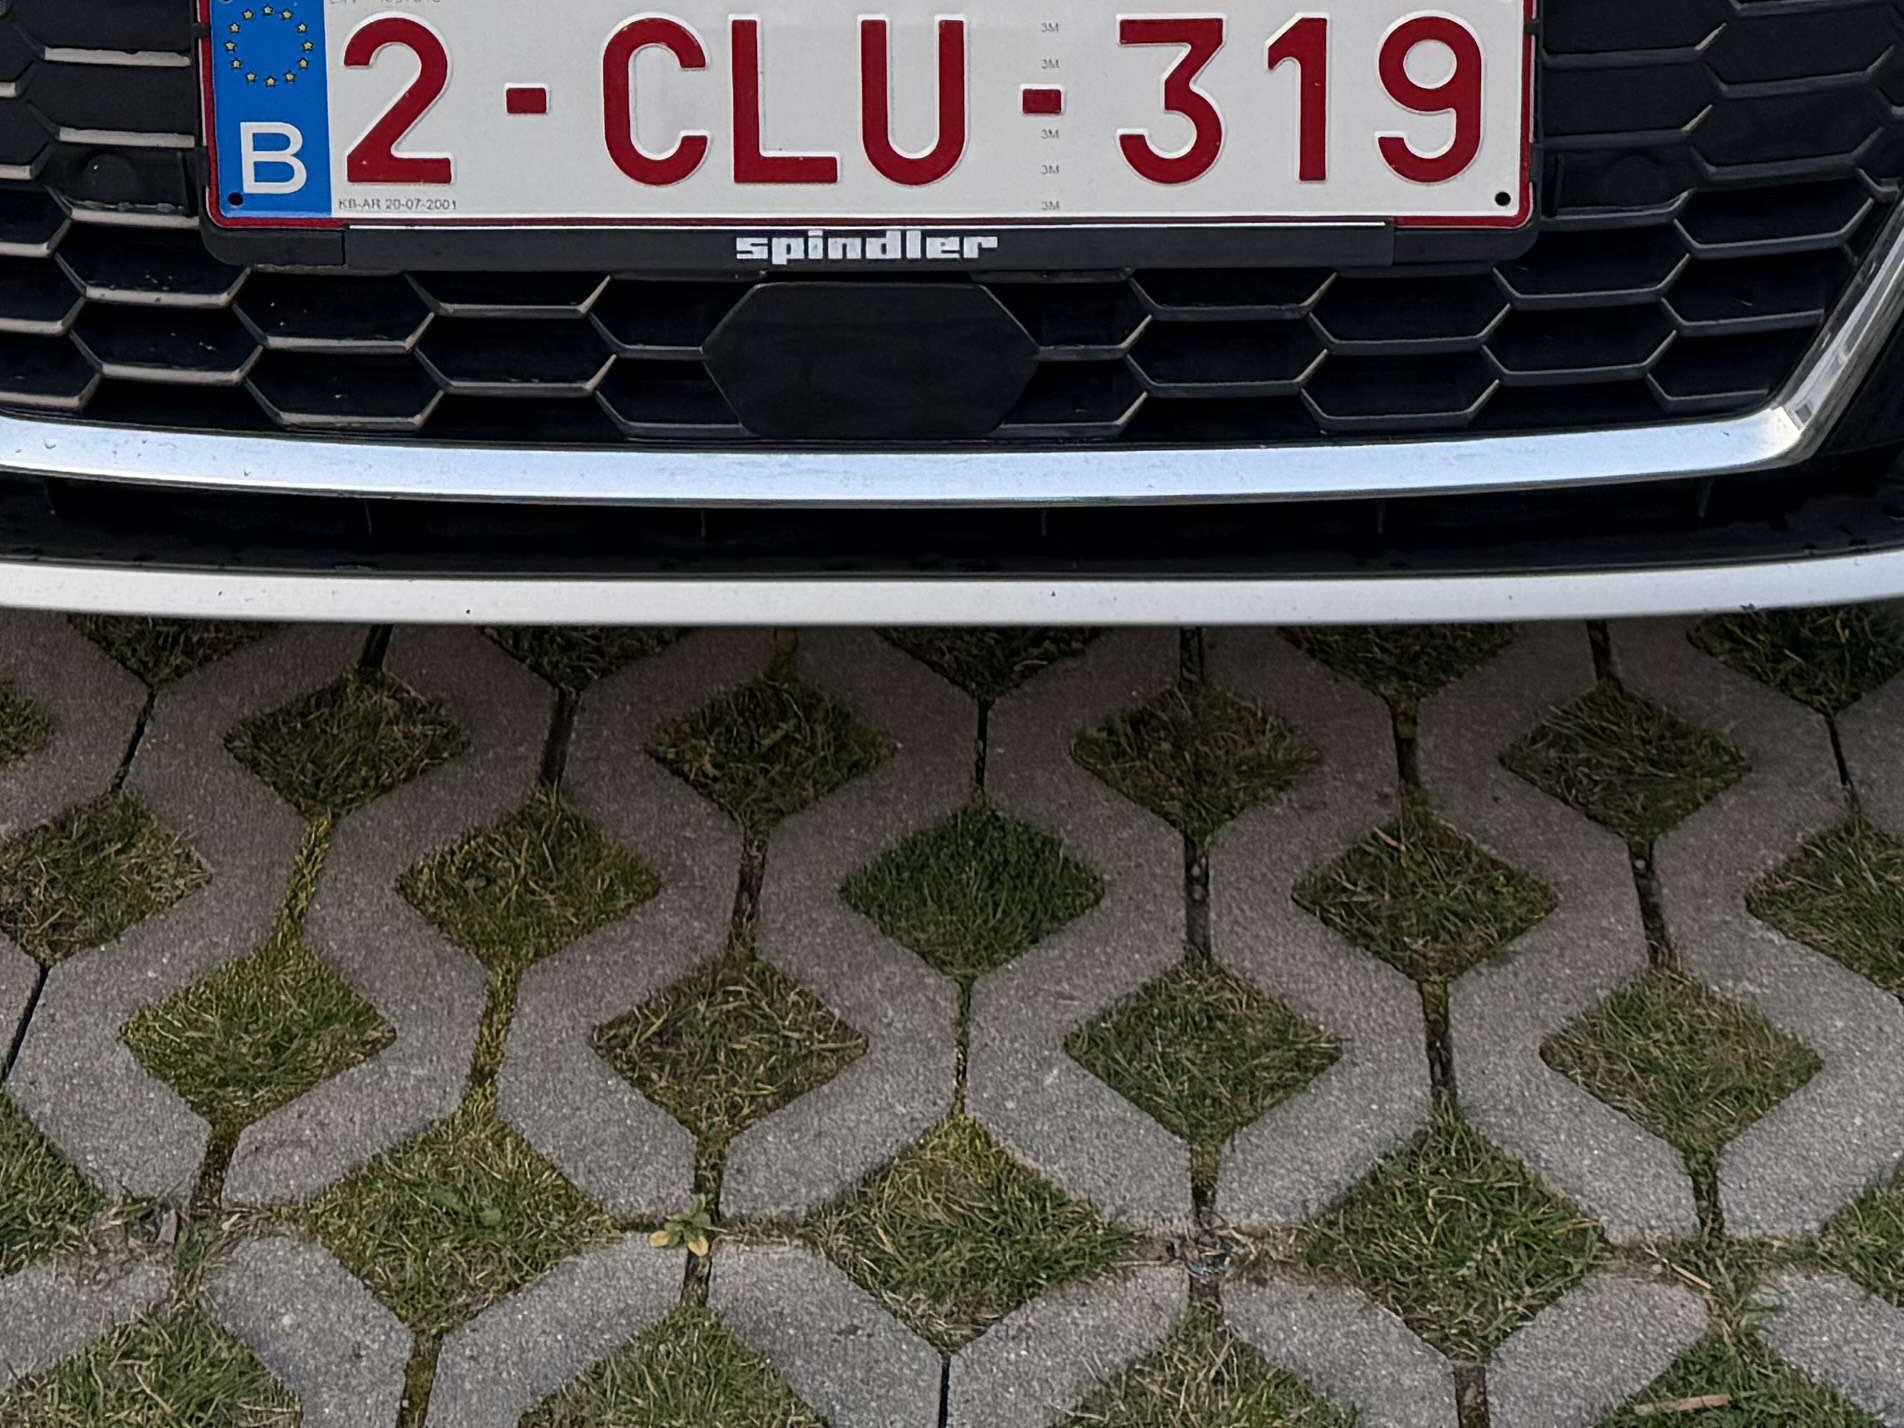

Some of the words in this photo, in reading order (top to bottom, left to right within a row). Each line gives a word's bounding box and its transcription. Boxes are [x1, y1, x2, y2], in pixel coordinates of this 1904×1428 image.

[1040, 22, 1059, 33] 3M
[1040, 58, 1060, 69] 3M
[343, 16, 1484, 186] 2-CLU-319
[1040, 128, 1060, 139] 3M
[240, 121, 308, 194] B
[1040, 164, 1060, 175] 3M
[338, 198, 381, 210] KB-AR
[384, 198, 457, 210] 20-07-2001
[1040, 200, 1060, 211] 3M
[735, 229, 998, 265] spindler
